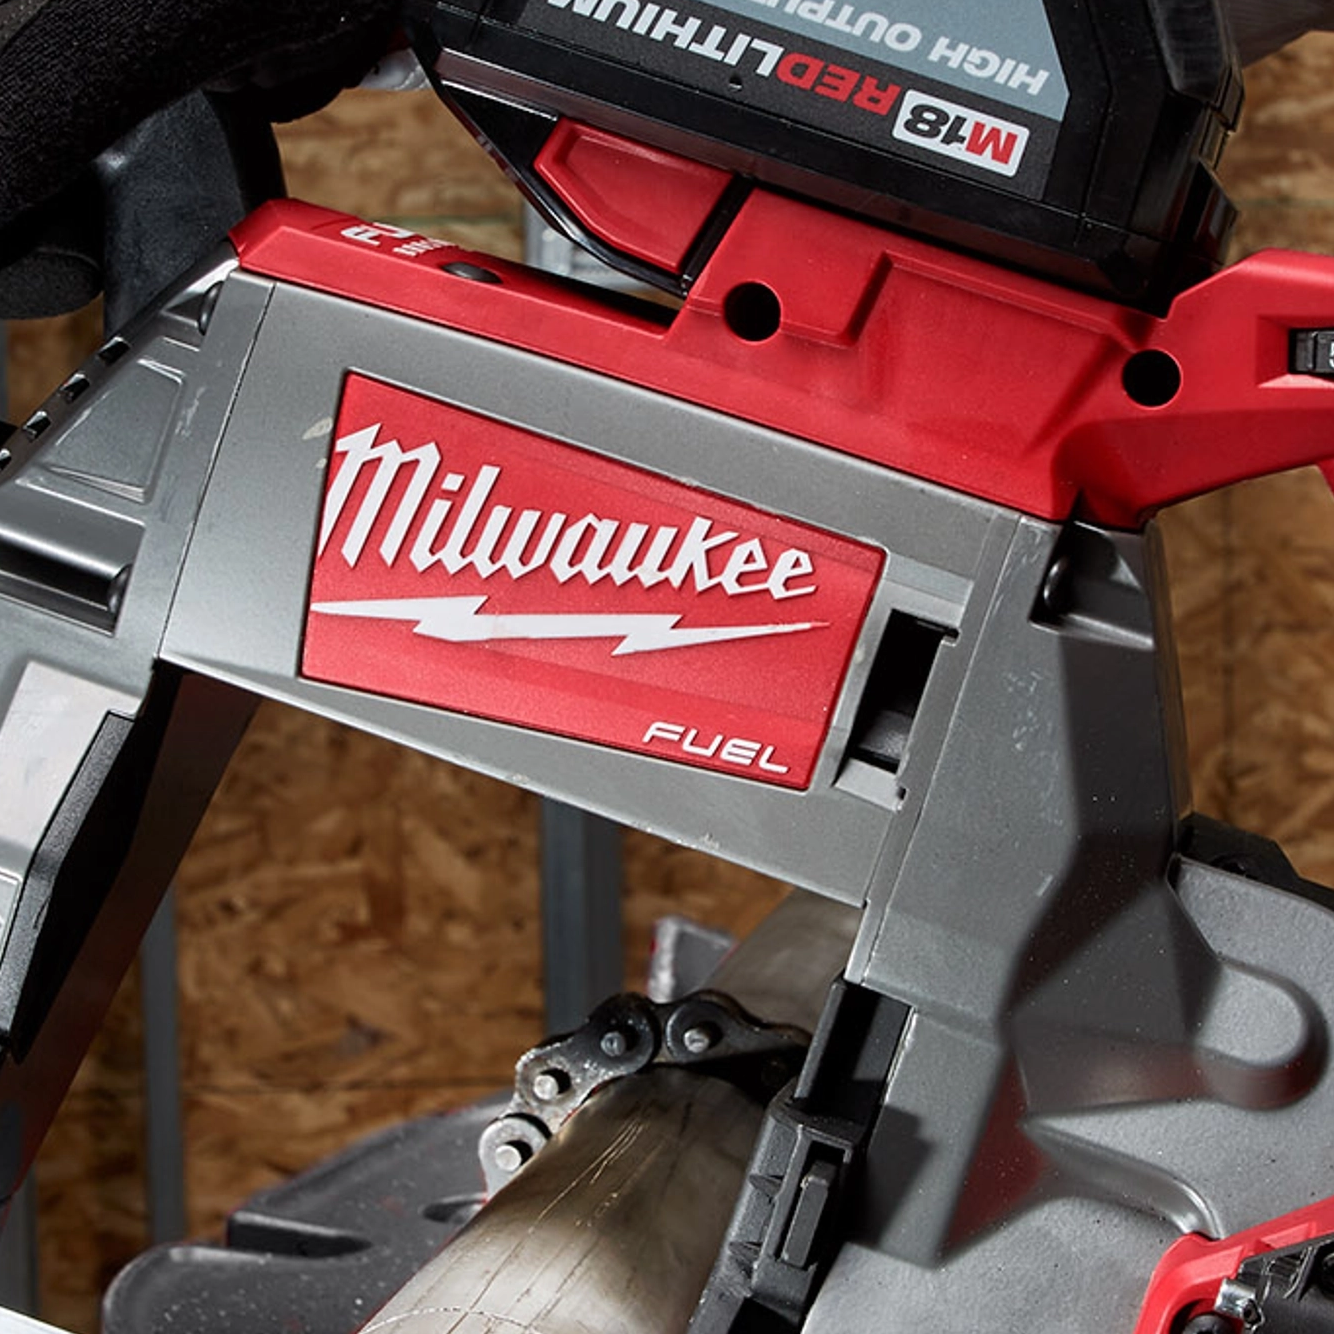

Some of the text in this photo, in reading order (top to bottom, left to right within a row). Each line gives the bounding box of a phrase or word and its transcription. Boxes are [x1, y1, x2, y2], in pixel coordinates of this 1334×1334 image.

[928, 35, 1051, 96] HIGH
[903, 103, 1020, 166] M18
[318, 423, 818, 600] Milwaukee
[642, 722, 789, 774] FUEL
